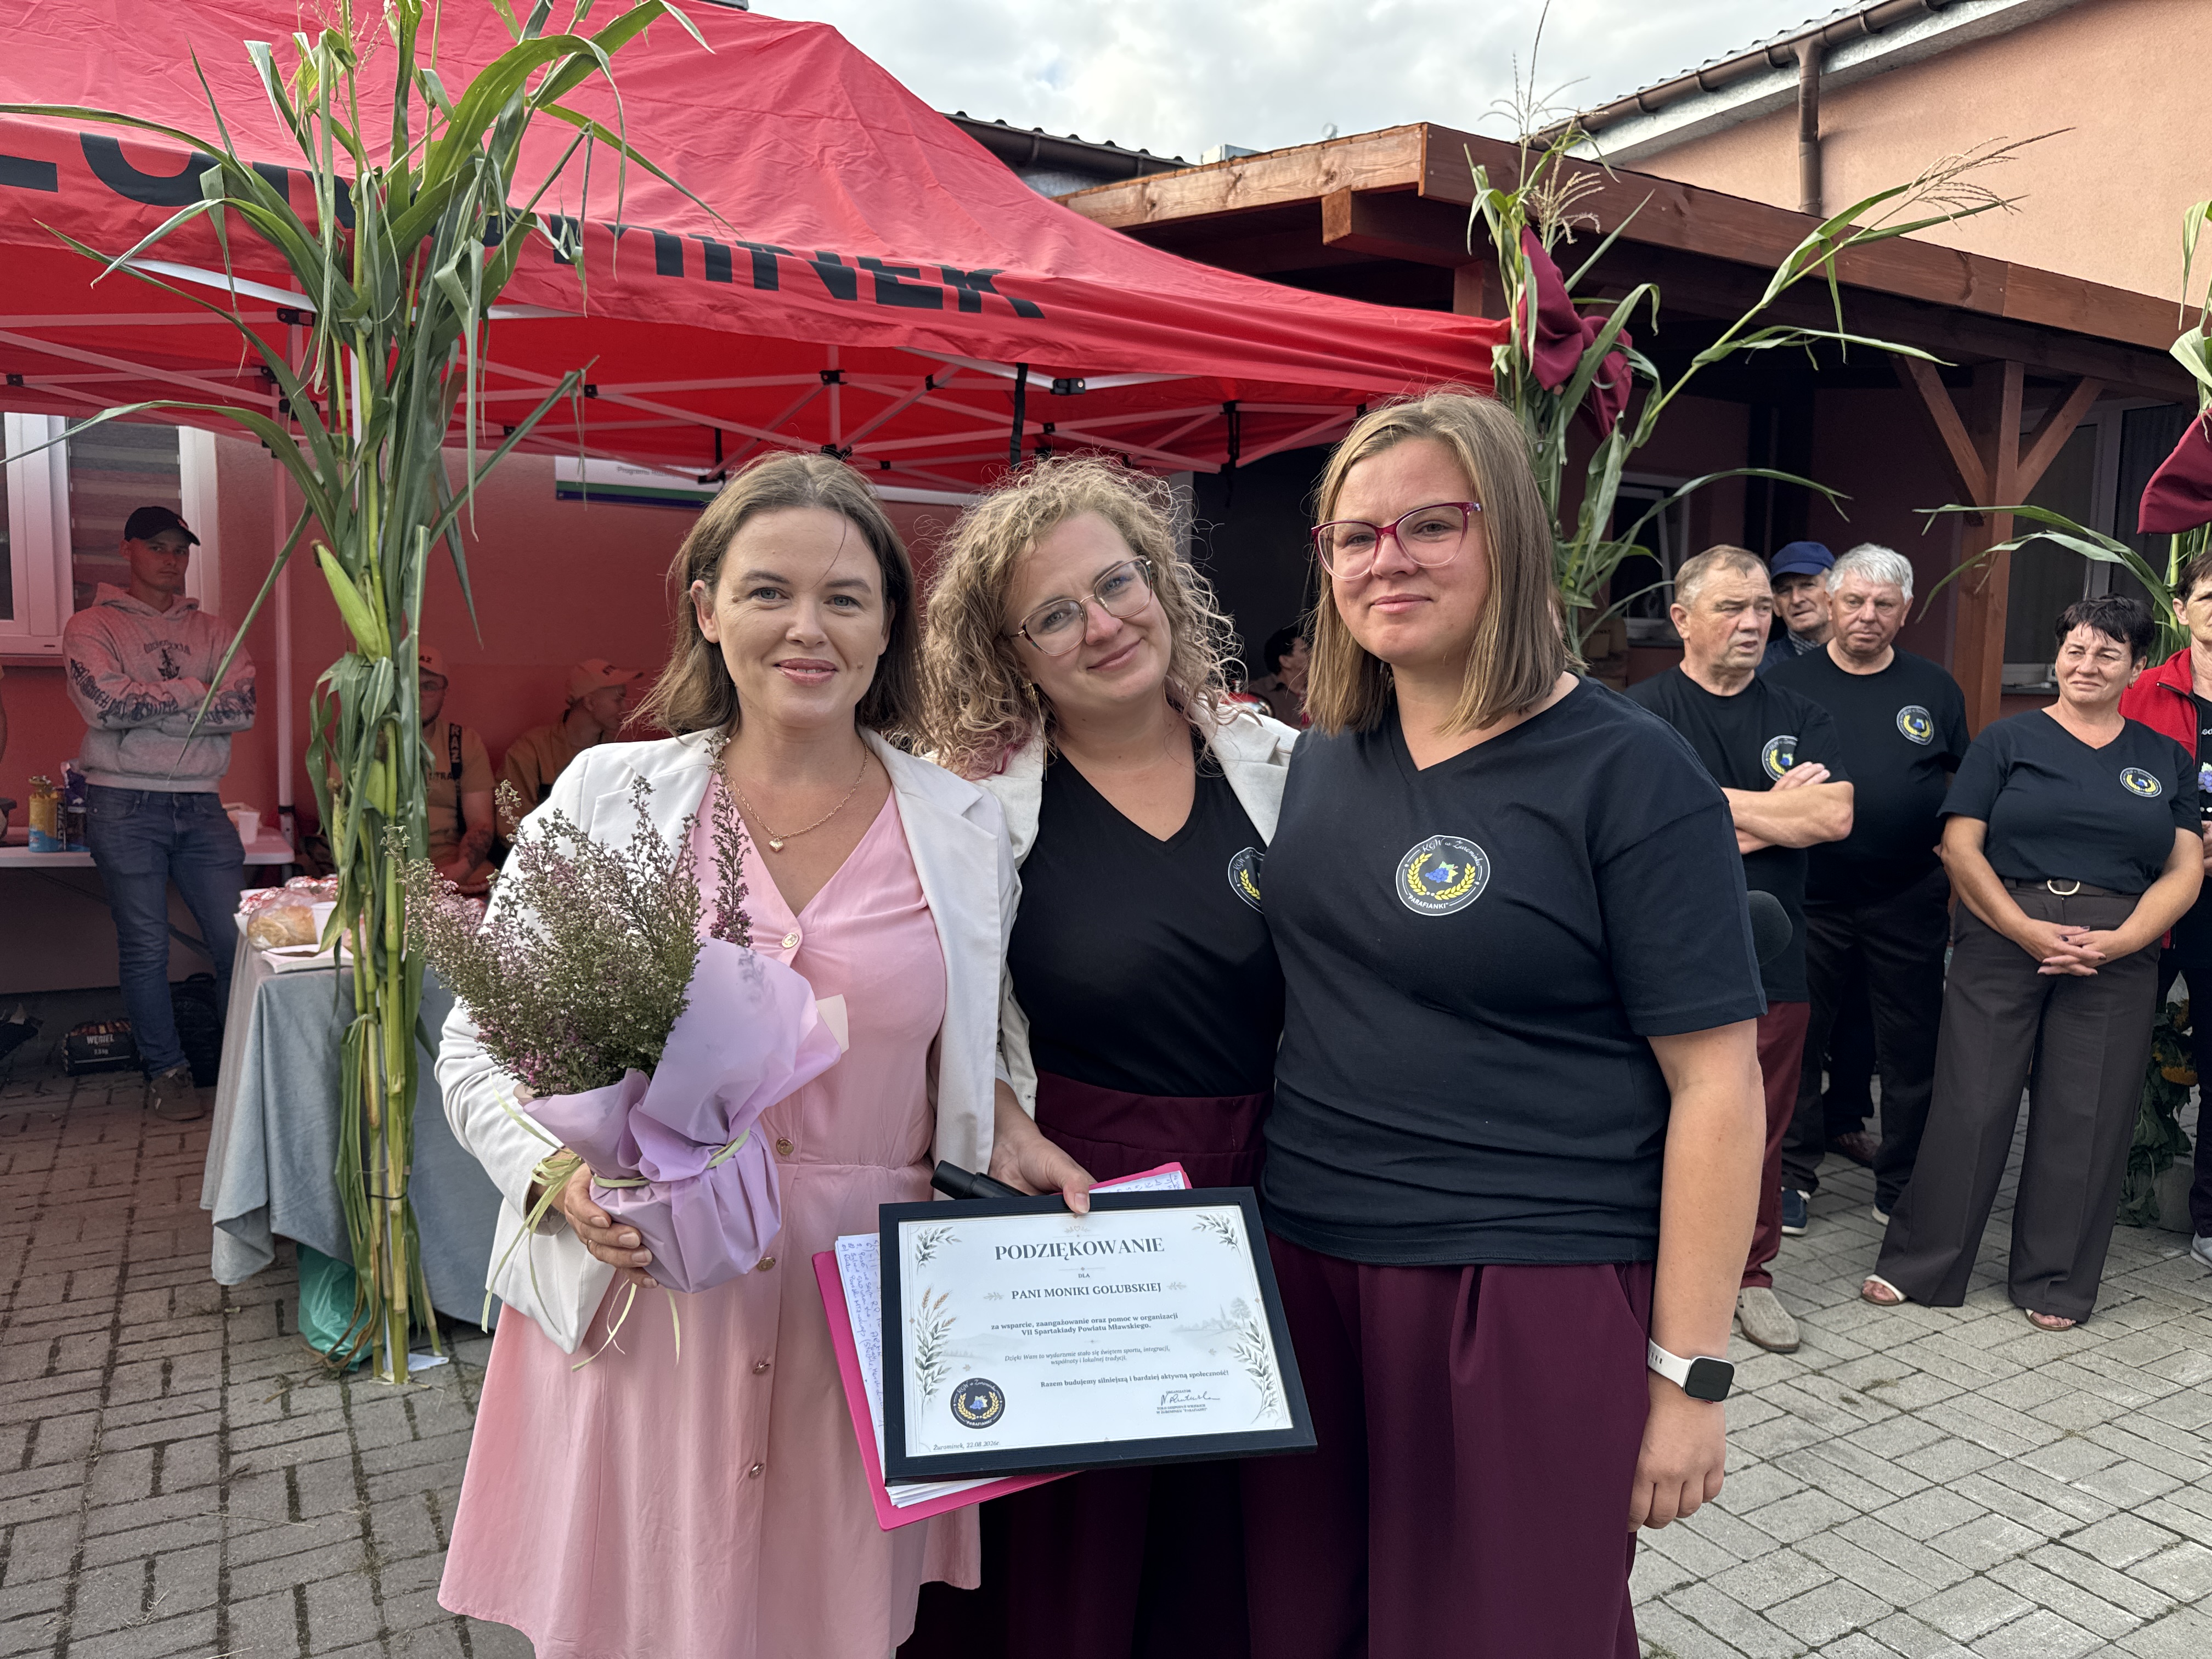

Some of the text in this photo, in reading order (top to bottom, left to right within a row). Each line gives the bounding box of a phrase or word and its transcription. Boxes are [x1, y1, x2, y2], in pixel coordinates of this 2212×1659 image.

[1422, 838, 1446, 853] KGW
[1453, 840, 1483, 867] Żurominku
[1408, 893, 1449, 909] "PARAFIANKI"
[995, 1237, 1165, 1261] PODZIĘKOWANIE
[1012, 1283, 1161, 1300] PANI MONIKI GOLUBSKIEJ
[1001, 1322, 1035, 1330] wsparcie,
[1036, 1318, 1090, 1327] zaangażowanie
[1140, 1312, 1178, 1322] organizacji
[1034, 1326, 1076, 1336] Spartakiady
[1108, 1322, 1152, 1330] Mławskiego.
[1046, 1351, 1076, 1359] wydarzenie
[1051, 1357, 1079, 1365] wspólnoty
[1160, 1372, 1188, 1380] aktywną
[1189, 1369, 1229, 1378] społeczność!
[933, 1443, 964, 1451] Żurominek,
